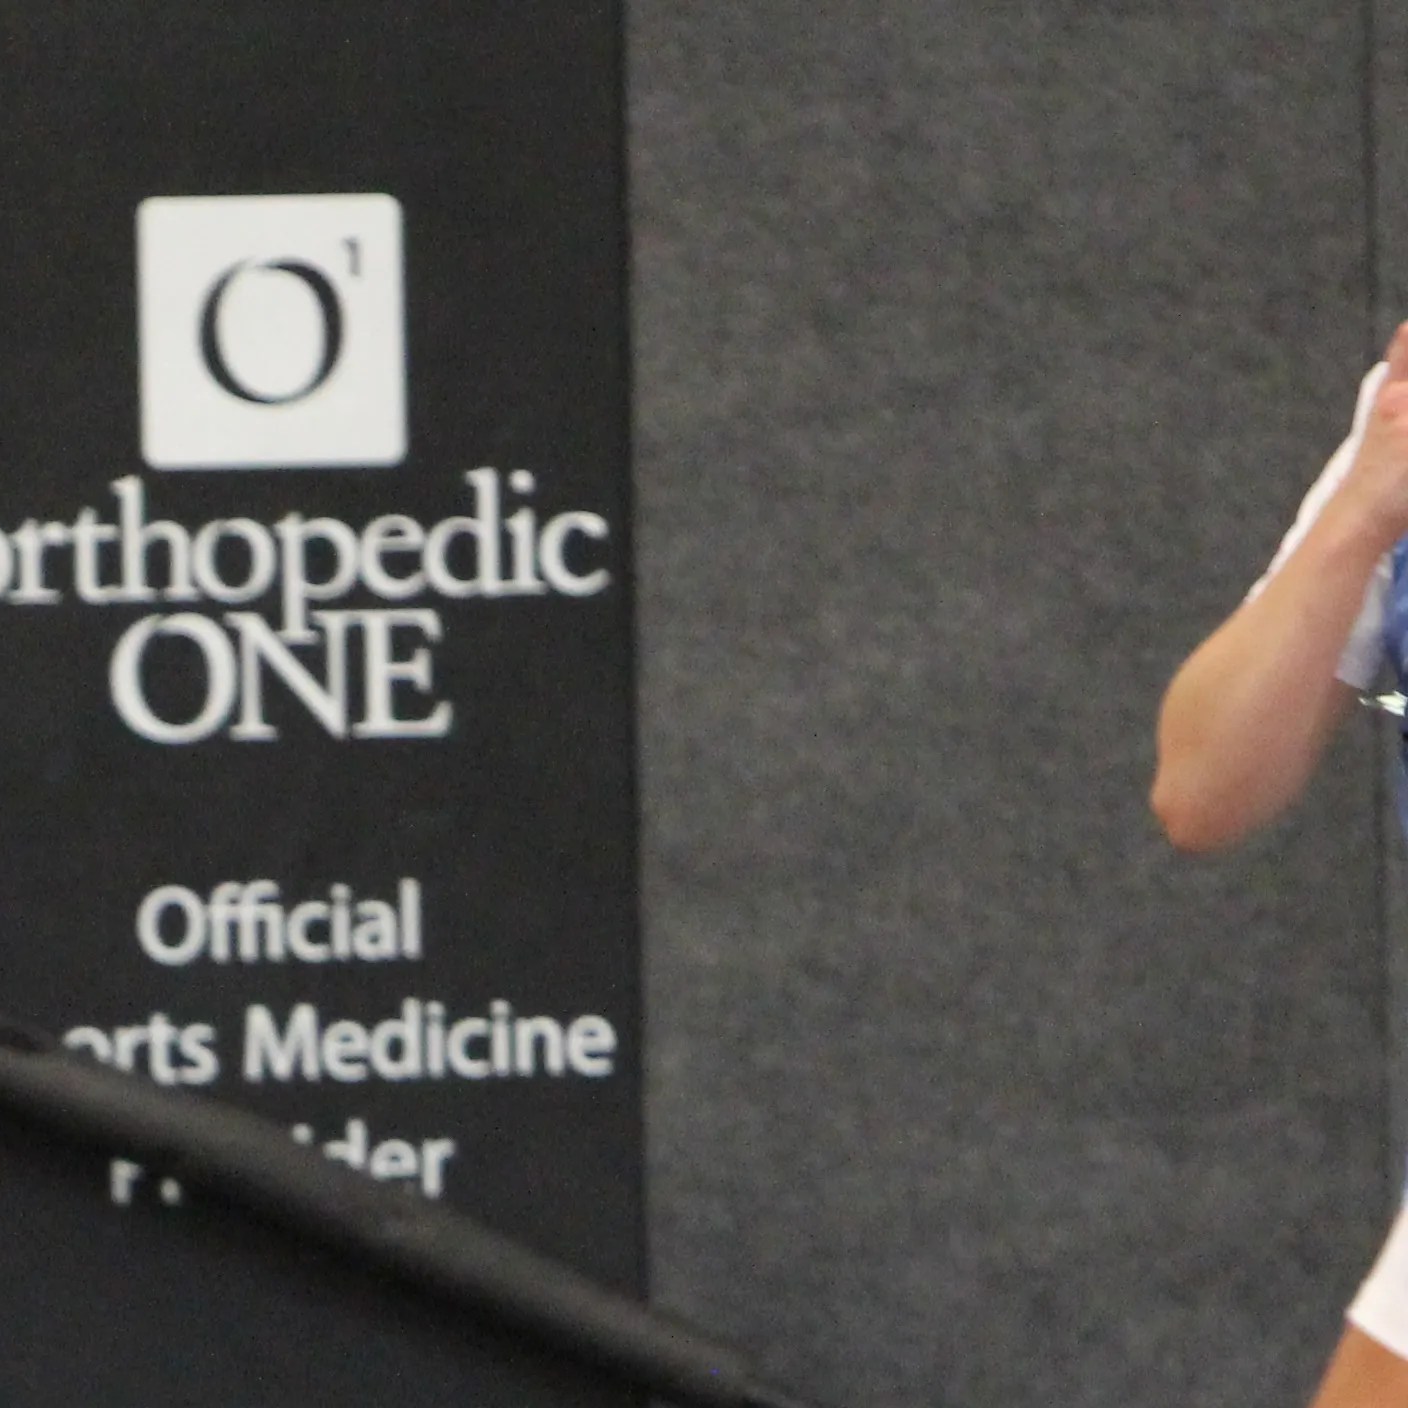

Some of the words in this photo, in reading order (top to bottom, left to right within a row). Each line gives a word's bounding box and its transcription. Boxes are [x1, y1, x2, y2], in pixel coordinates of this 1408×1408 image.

[109, 607, 454, 744] ONE
[136, 876, 423, 966] Official
[242, 996, 617, 1083] Medicine
